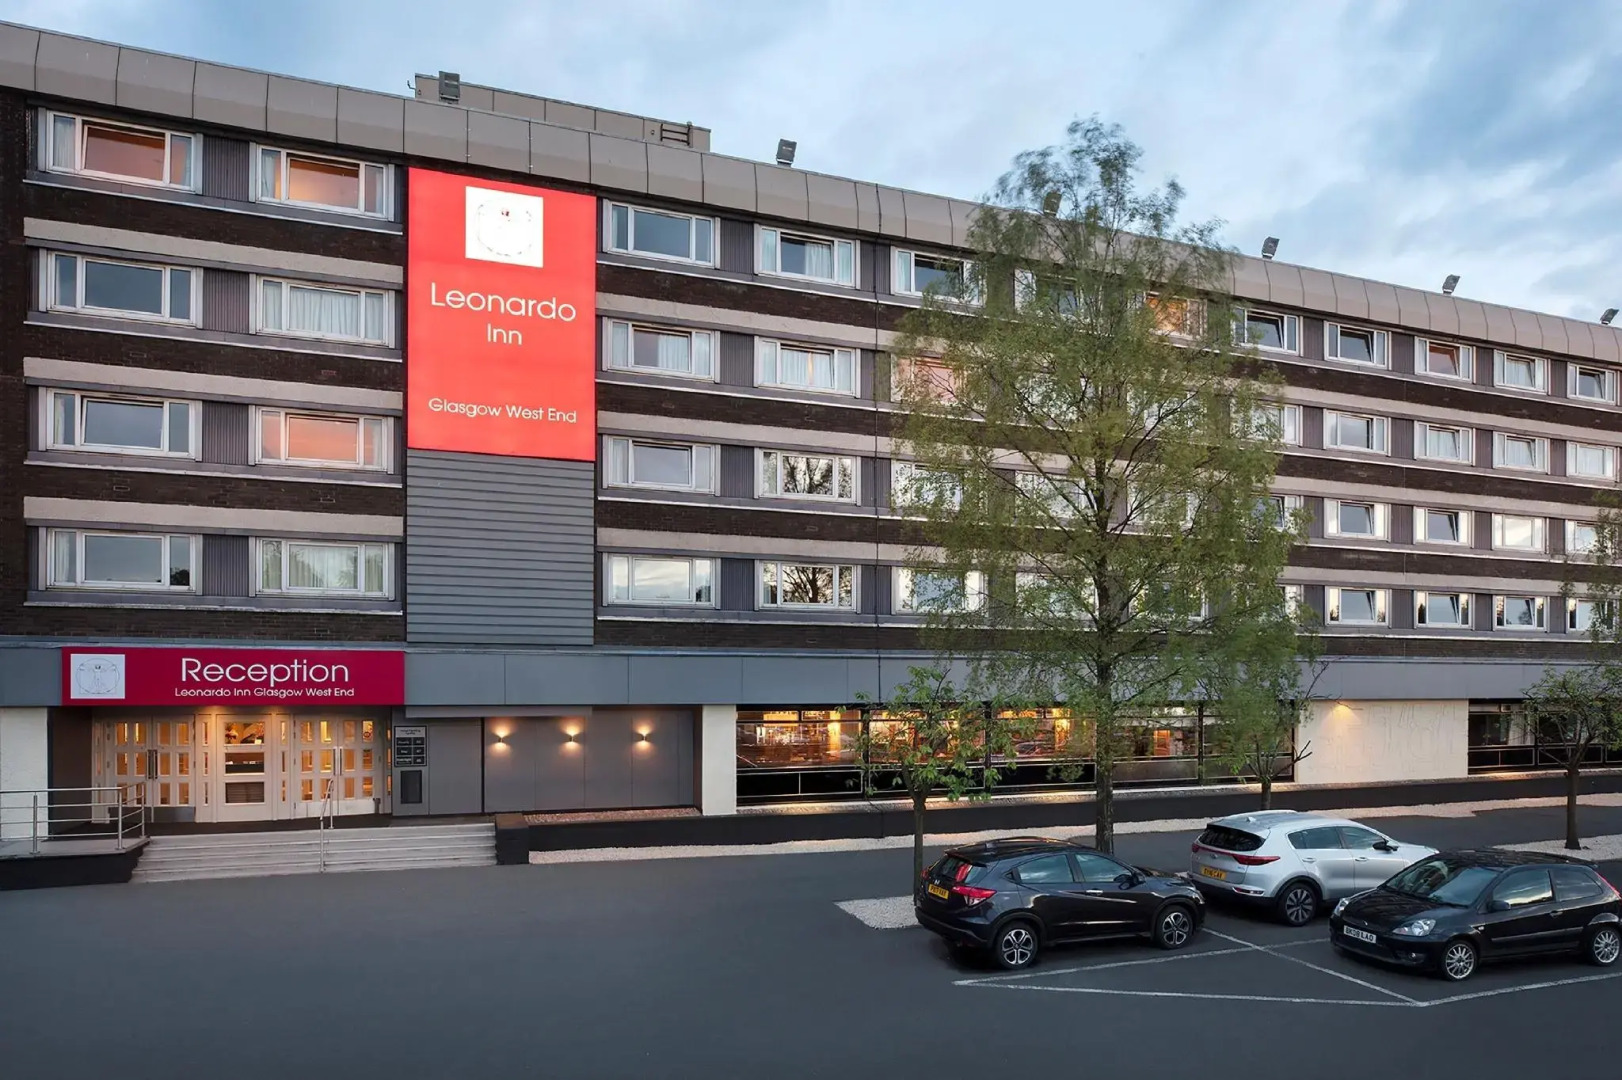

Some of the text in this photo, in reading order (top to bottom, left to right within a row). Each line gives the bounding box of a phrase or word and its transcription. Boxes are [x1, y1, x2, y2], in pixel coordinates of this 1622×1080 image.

[431, 281, 577, 322] Leonardo
[487, 323, 523, 346] Inn
[428, 397, 577, 424] Glasgow West End
[181, 657, 349, 687] Reception
[174, 687, 355, 699] Leonardo Inn Glasgow West End
